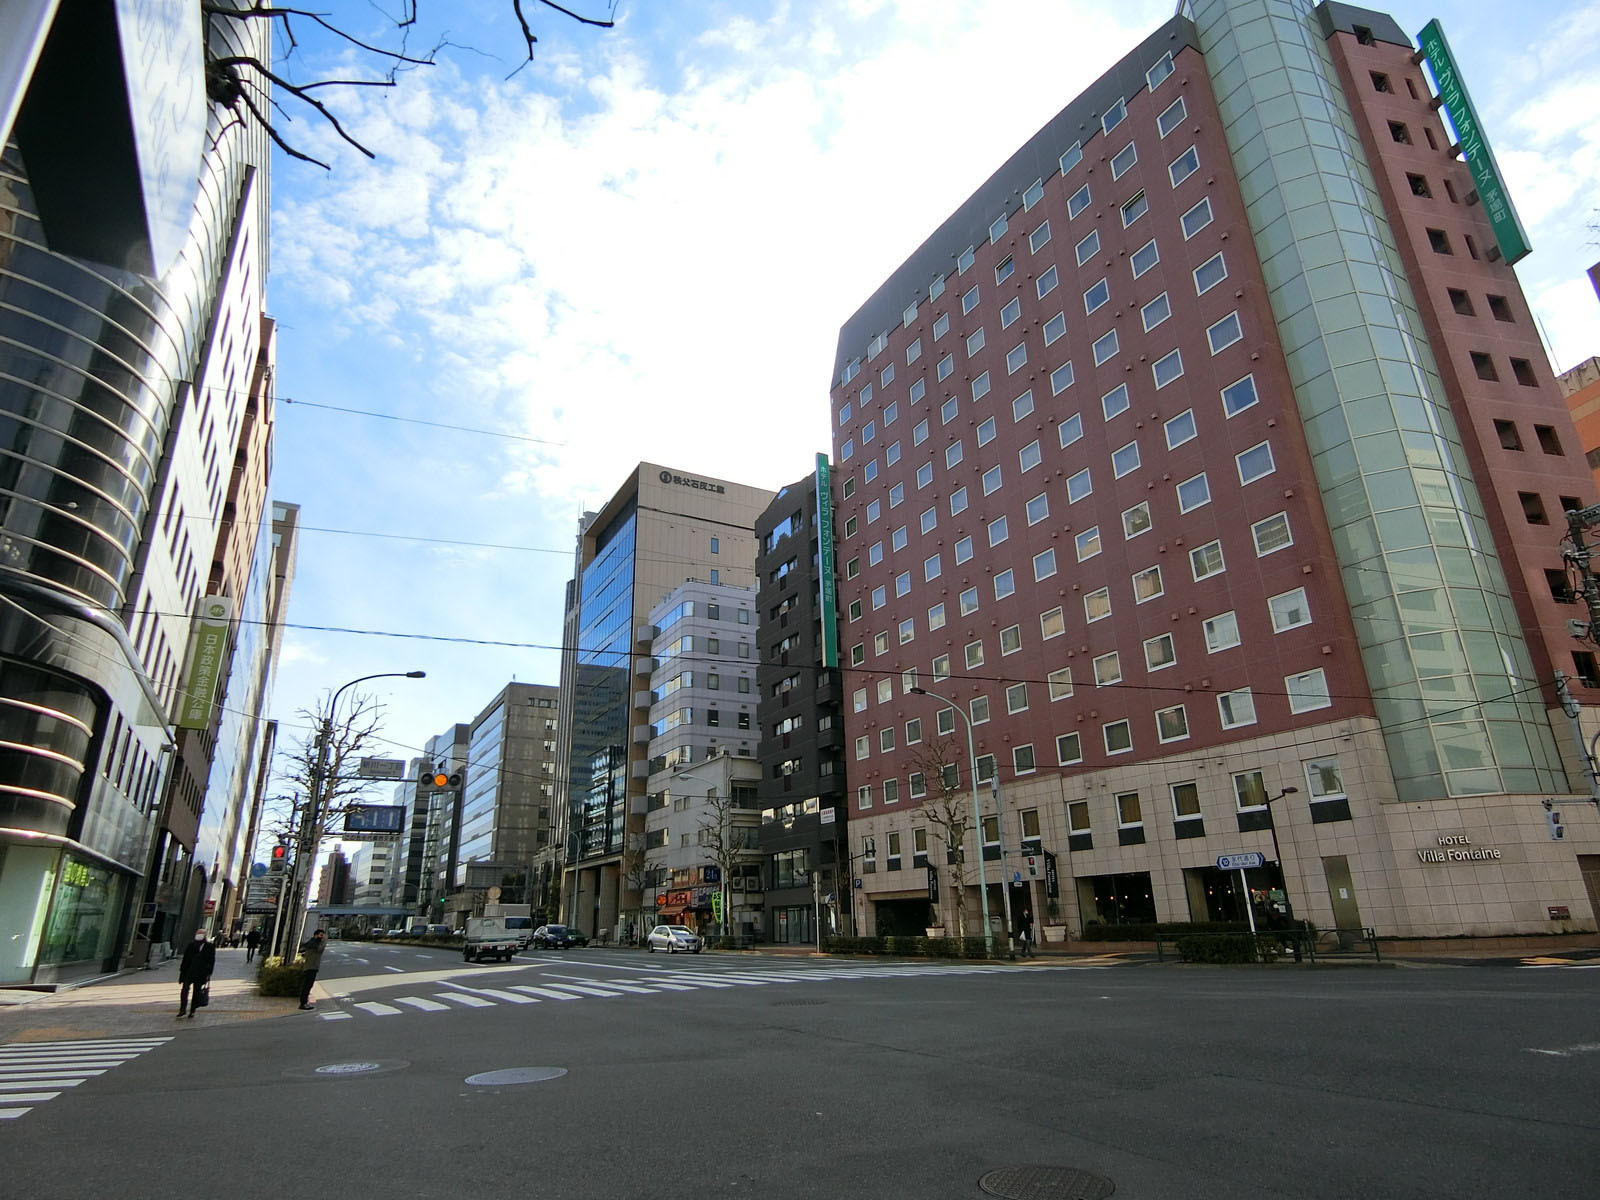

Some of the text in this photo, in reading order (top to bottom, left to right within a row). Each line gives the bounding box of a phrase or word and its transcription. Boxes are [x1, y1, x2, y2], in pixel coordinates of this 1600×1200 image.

[1426, 40, 1445, 71] ホテル
[1439, 66, 1460, 108] ヴィラ
[1453, 107, 1492, 187] フォンテーヌ
[820, 466, 828, 487] ホテル
[1438, 835, 1472, 846] HOTEL
[1417, 847, 1501, 863] Villa Fontaine
